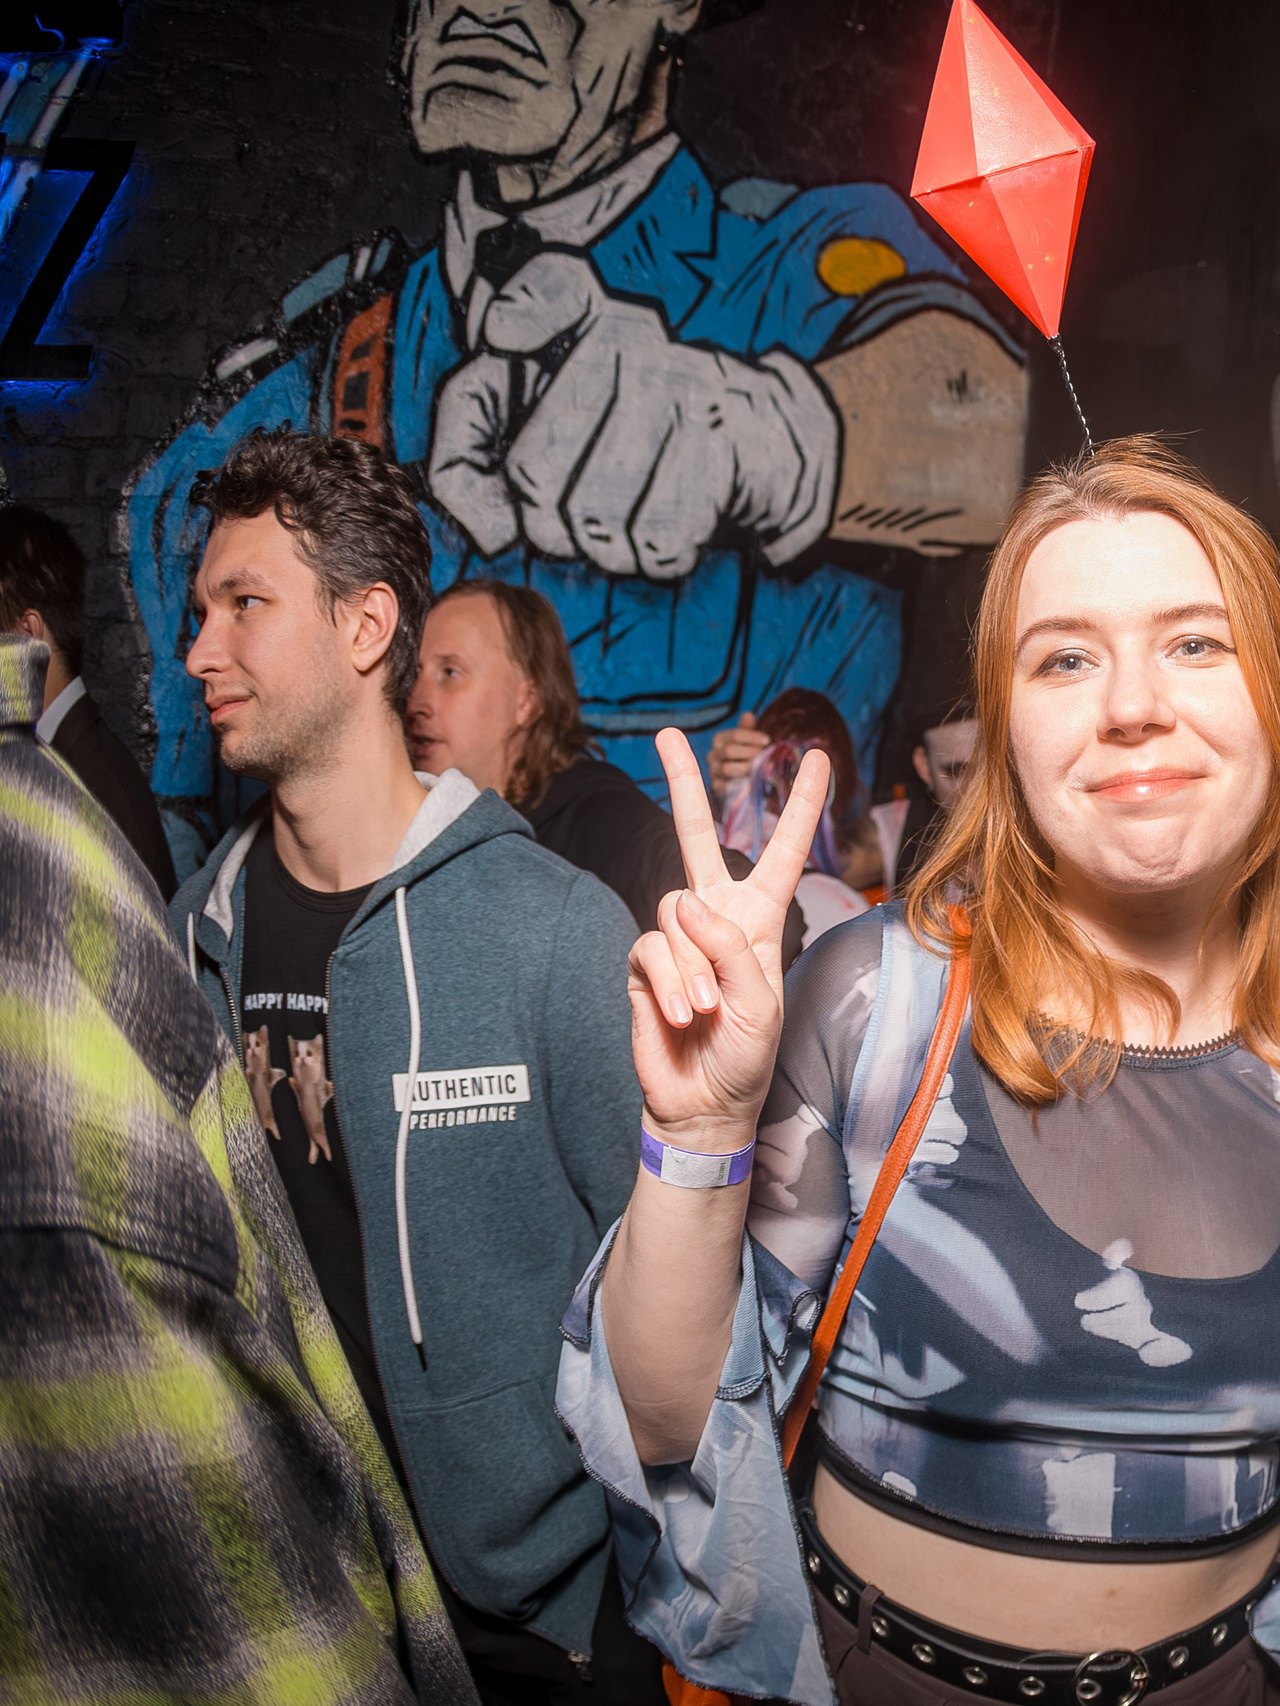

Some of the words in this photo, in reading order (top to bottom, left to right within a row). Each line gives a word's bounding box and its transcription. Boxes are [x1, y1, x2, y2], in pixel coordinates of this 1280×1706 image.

[244, 993, 283, 1011] HAPPY
[286, 993, 329, 1014] HAPPY
[409, 1105, 517, 1131] PERFORMANCE
